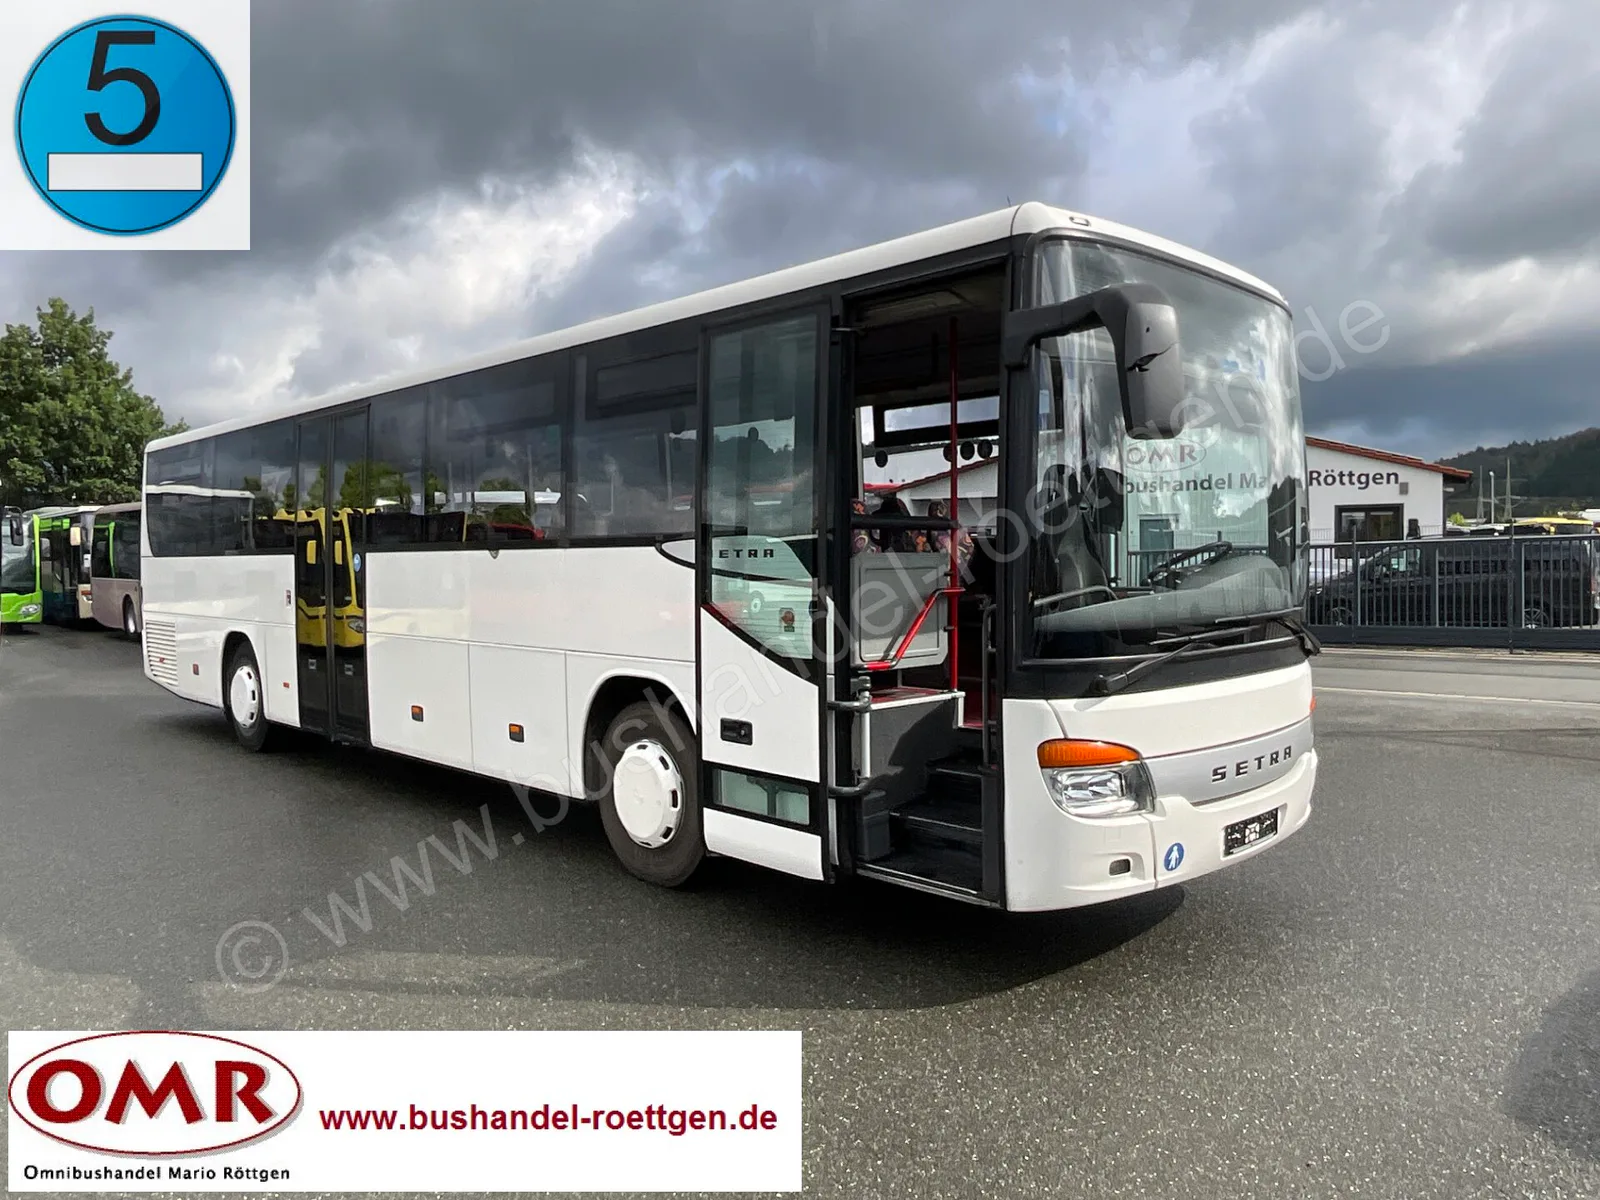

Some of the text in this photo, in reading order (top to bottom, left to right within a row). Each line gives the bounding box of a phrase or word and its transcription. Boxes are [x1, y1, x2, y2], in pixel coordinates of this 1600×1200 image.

[1126, 444, 1198, 465] OMR
[1308, 469, 1399, 490] Röttgen
[1211, 745, 1292, 783] SETRA
